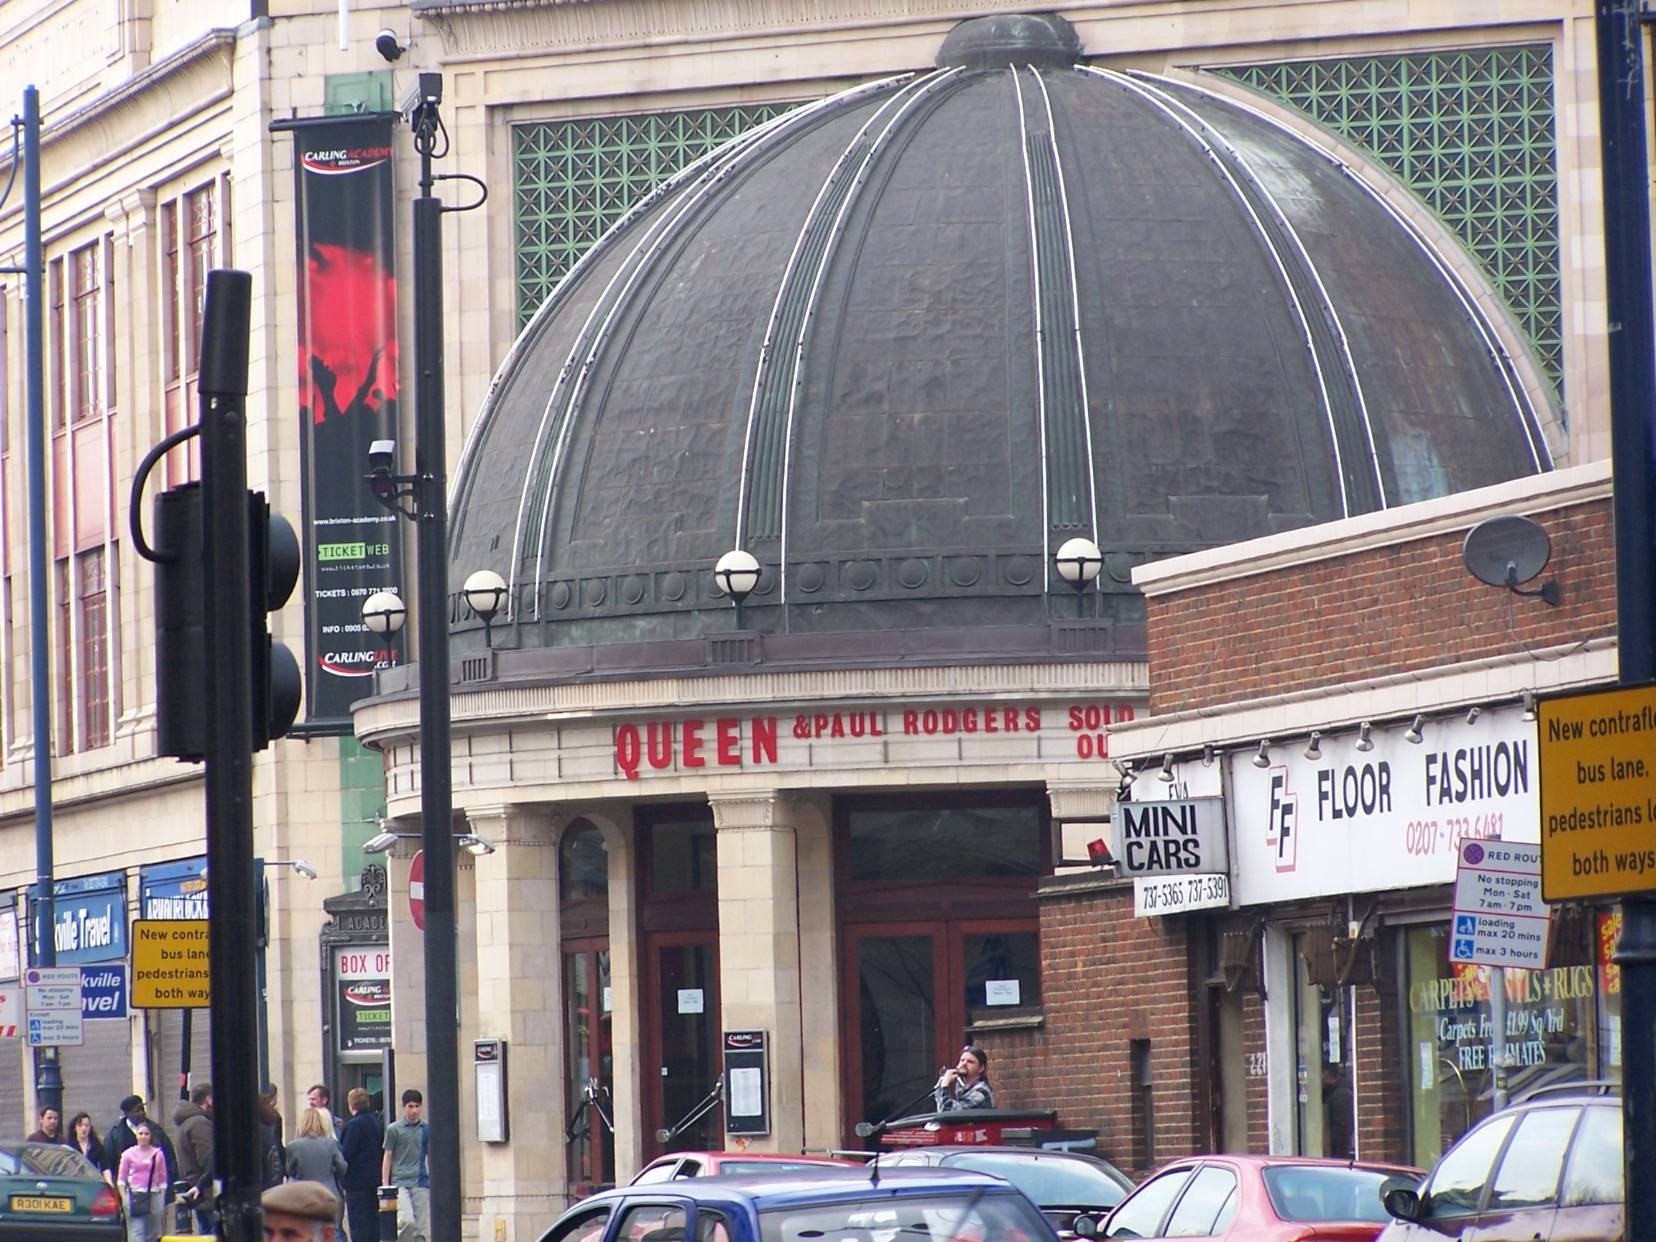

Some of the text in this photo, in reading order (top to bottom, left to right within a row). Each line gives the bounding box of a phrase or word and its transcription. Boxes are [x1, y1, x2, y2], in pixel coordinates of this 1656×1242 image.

[322, 625, 340, 633] INFO
[1549, 717, 1584, 742] New
[616, 716, 778, 782] QUEEN
[903, 706, 1041, 735] RODGERS
[1318, 761, 1392, 821] FLOOR
[1425, 739, 1528, 807] FASHION
[1577, 756, 1649, 784] bus lane.
[1123, 804, 1198, 838] MINI
[1549, 801, 1642, 838] pedestrians
[1126, 838, 1201, 871] CARS
[1488, 851, 1541, 863] RED ROU
[1573, 850, 1609, 877] both
[1478, 875, 1539, 888] No stopping
[1143, 876, 1228, 910] 737-5365 737-5391
[1483, 888, 1531, 899] Mon Sat
[79, 904, 111, 949] Travel
[140, 928, 168, 940] New
[1479, 917, 1515, 929] loading
[1477, 929, 1541, 942] max 20 mins
[161, 948, 183, 960] bus
[1476, 946, 1538, 959] max 3 hours
[137, 968, 209, 981] pedestrians
[341, 954, 367, 974] BOX
[81, 972, 121, 988] kville
[1409, 977, 1474, 1013] CARPETS
[1553, 965, 1594, 1000] RUGS
[155, 987, 183, 998] both
[1440, 1016, 1476, 1047] Carpets
[1459, 1045, 1485, 1070] FREE
